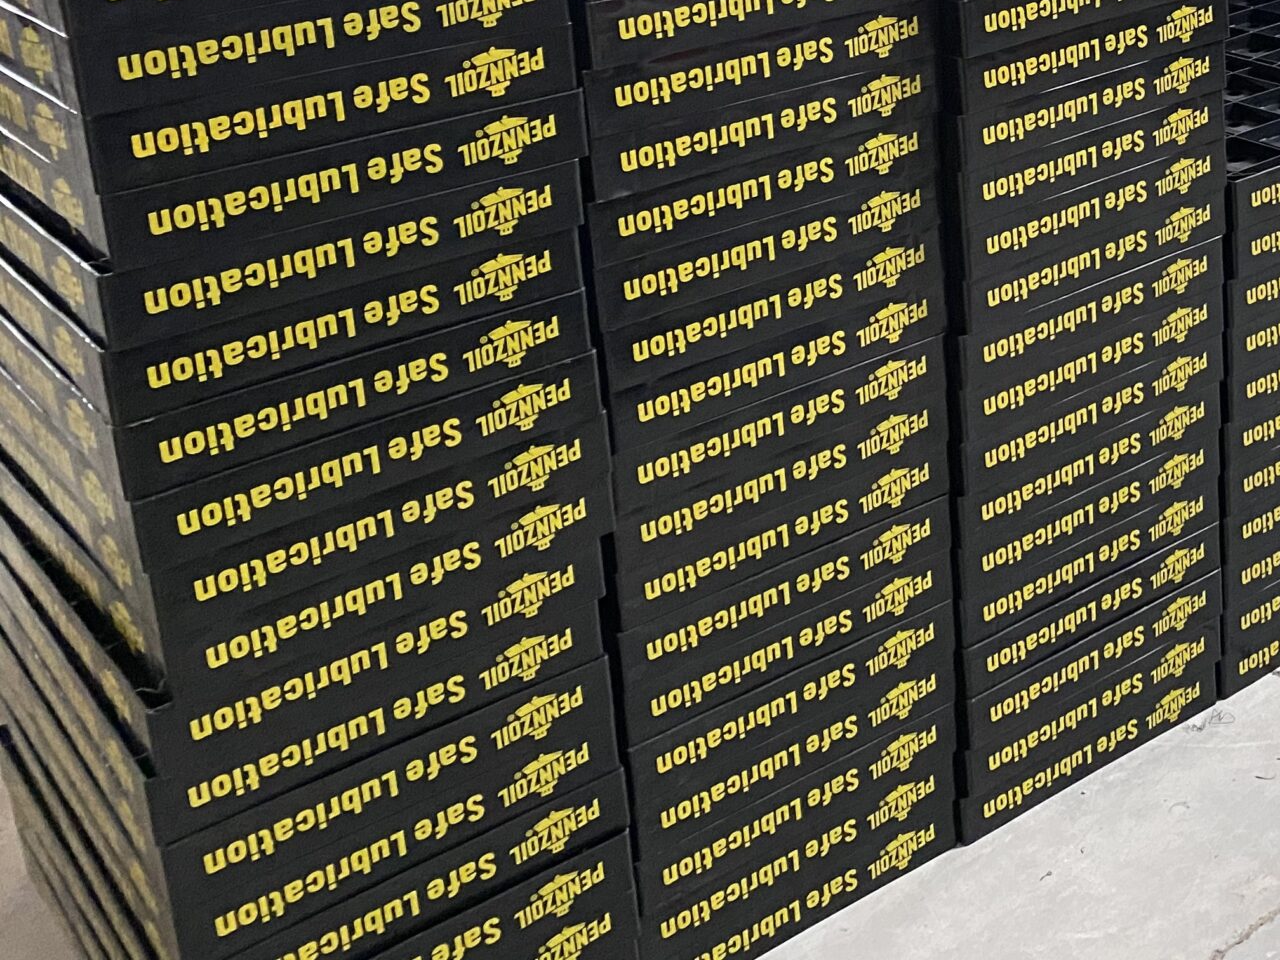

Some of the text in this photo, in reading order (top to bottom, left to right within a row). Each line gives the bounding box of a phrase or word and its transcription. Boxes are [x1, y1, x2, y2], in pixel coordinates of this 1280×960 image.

[117, 17, 335, 81] Lubrication
[343, 1, 422, 41] Safe
[983, 10, 1214, 89] PENNZOIL Safe Lubrication
[146, 249, 552, 389] PENNZOIL Safe Lubrication
[637, 302, 928, 423] PENNZOIL Safe Lubrication
[985, 356, 1208, 468] PENNZOIL Safe Lubrication
[205, 497, 587, 669] PENNZOIL Safe Lubrication
[646, 519, 931, 661] PENNZOIL Safe Lubrication
[662, 727, 937, 886] PENNZOIL Safe Lubrication
[984, 687, 1201, 817] PENNZOIL Safe Lubrication
[214, 744, 589, 937] PENNZOIL Safe Lubrication
